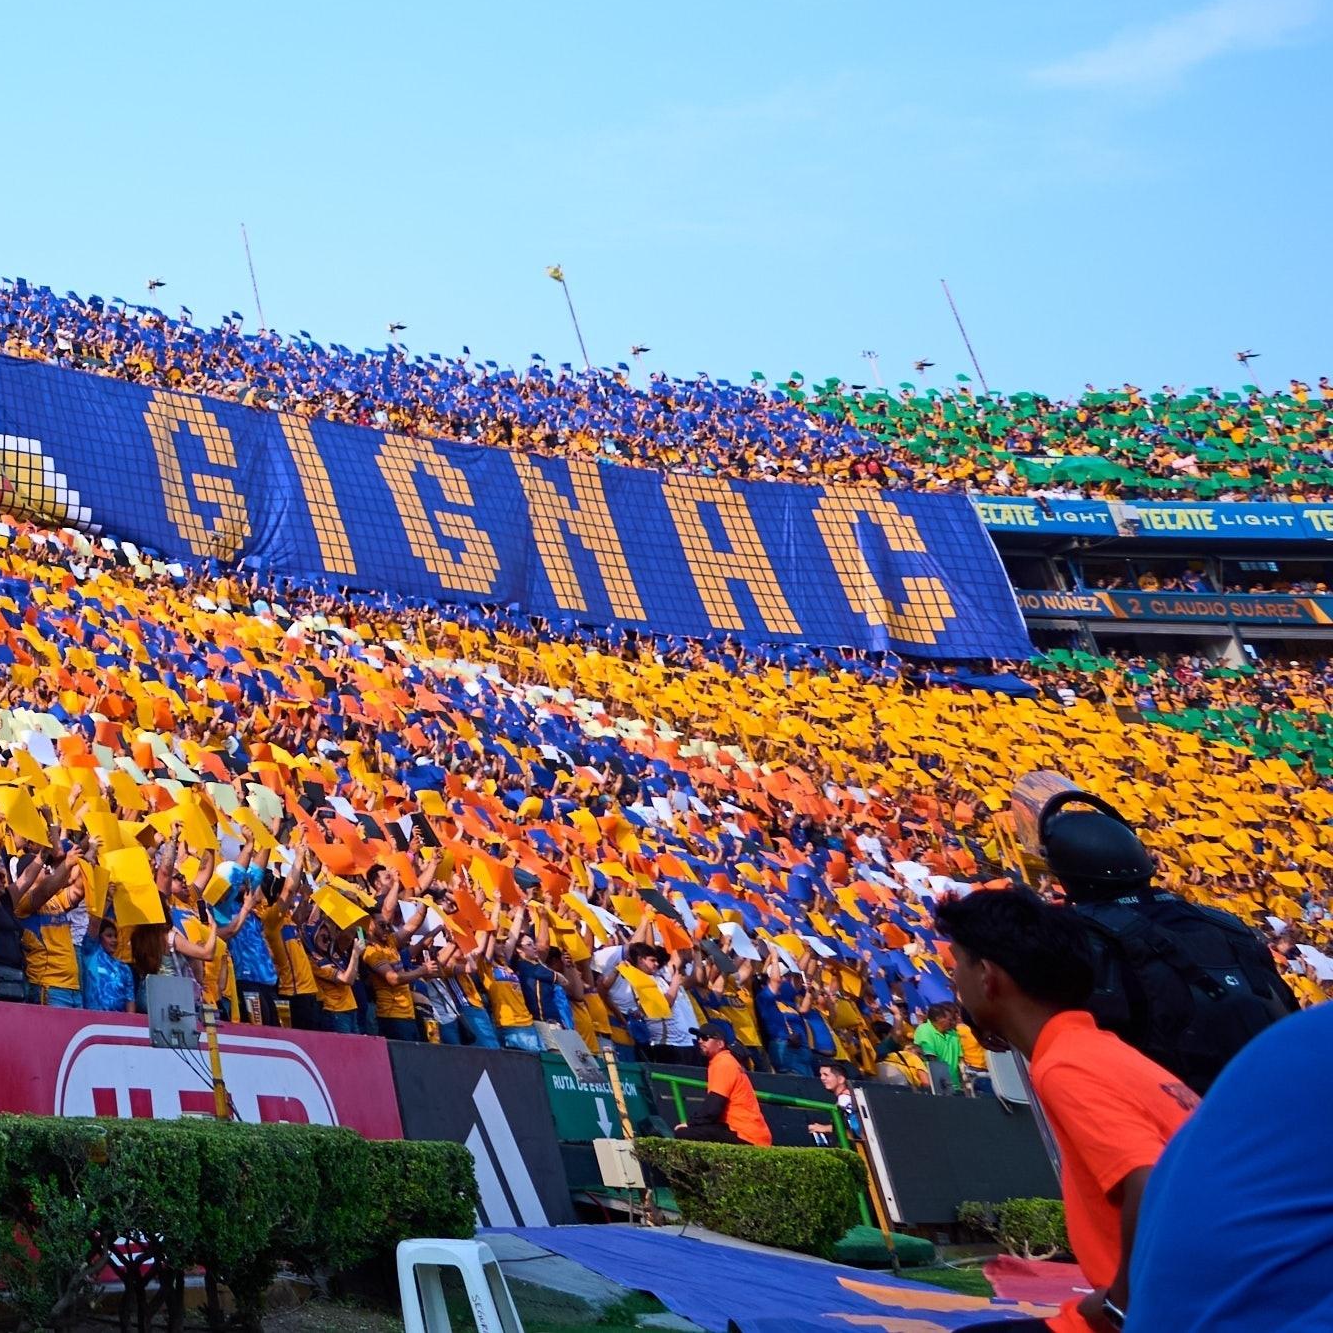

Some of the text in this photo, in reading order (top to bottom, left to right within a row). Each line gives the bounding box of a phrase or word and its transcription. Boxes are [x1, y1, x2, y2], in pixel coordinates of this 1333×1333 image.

[142, 389, 957, 645] GIGNAC
[976, 502, 1108, 526] ECATE LIGHT
[1135, 508, 1295, 531] TECATE LIGHT
[1041, 591, 1102, 612] NÚÑEZ
[1128, 598, 1302, 618] 2 CLAUDIO SUÁREZ
[552, 1074, 576, 1091] RUTA
